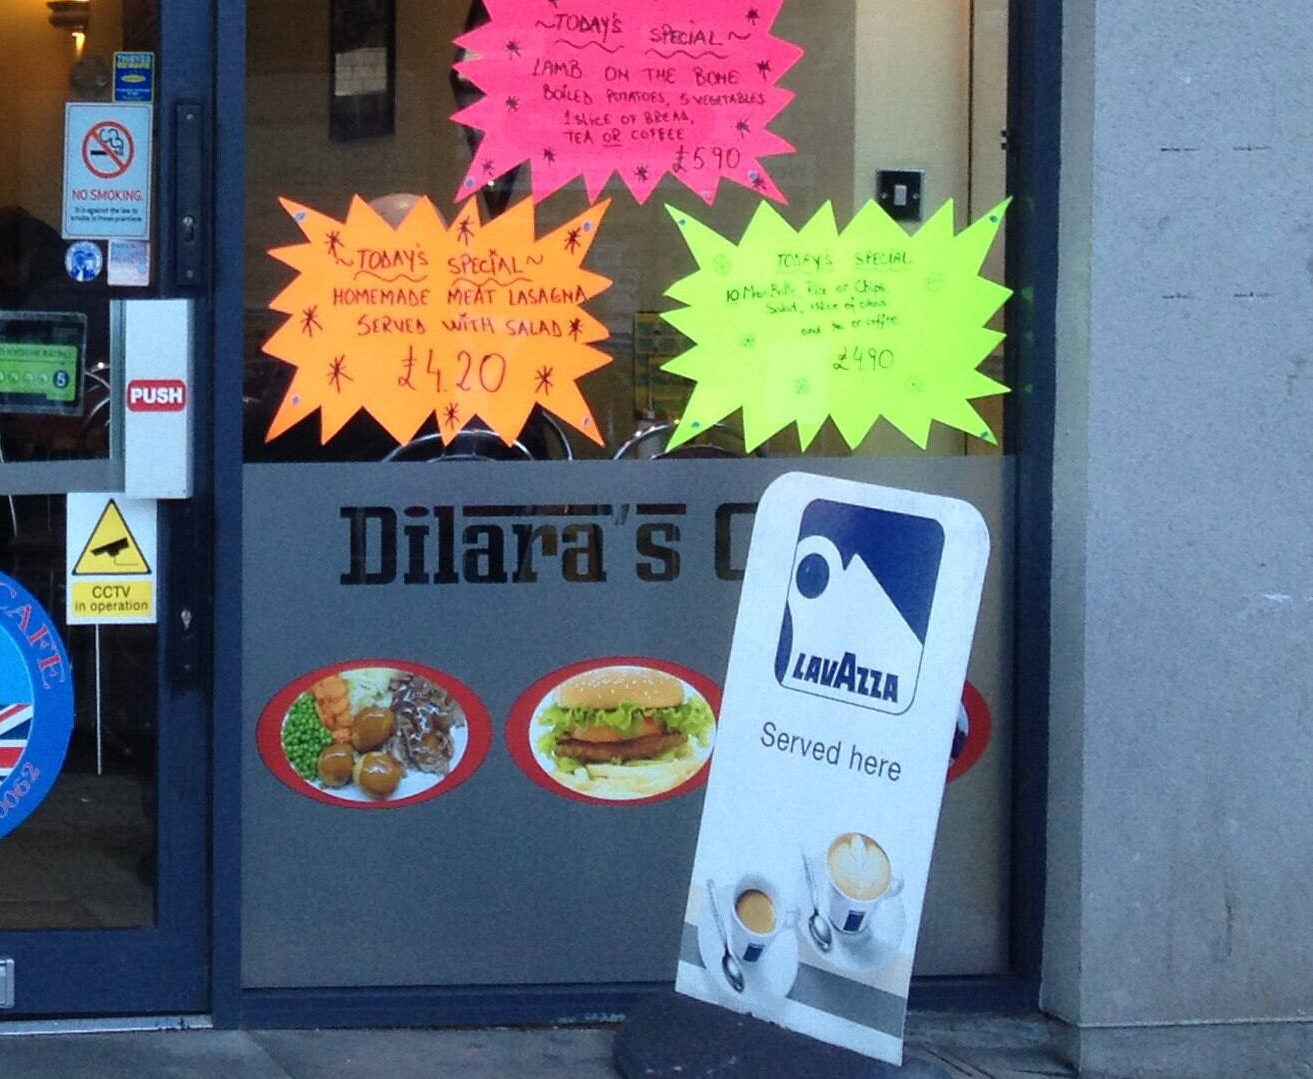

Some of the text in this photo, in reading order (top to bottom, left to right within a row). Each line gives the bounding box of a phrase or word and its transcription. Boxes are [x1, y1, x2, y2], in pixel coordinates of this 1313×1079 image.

[649, 19, 723, 46] SPECIAL
[532, 59, 740, 87] LAMB ON THE BONE
[542, 84, 593, 106] BOILED
[680, 93, 690, 107] 5
[693, 93, 766, 106] VEGETABLES
[564, 127, 685, 145] TEA OR COFFEE
[72, 189, 88, 201] NO
[448, 249, 524, 276] SPECIAL
[333, 285, 589, 307] HOMEMADE MEAT LASAGNA
[357, 312, 562, 337] SERVED WITH SALAD
[130, 387, 184, 404] PUSH
[339, 503, 687, 585] Dilara's
[92, 585, 131, 599] CCTV
[75, 600, 148, 613] in operation
[792, 651, 899, 703] LAVAZZA
[760, 721, 902, 782] Served here
